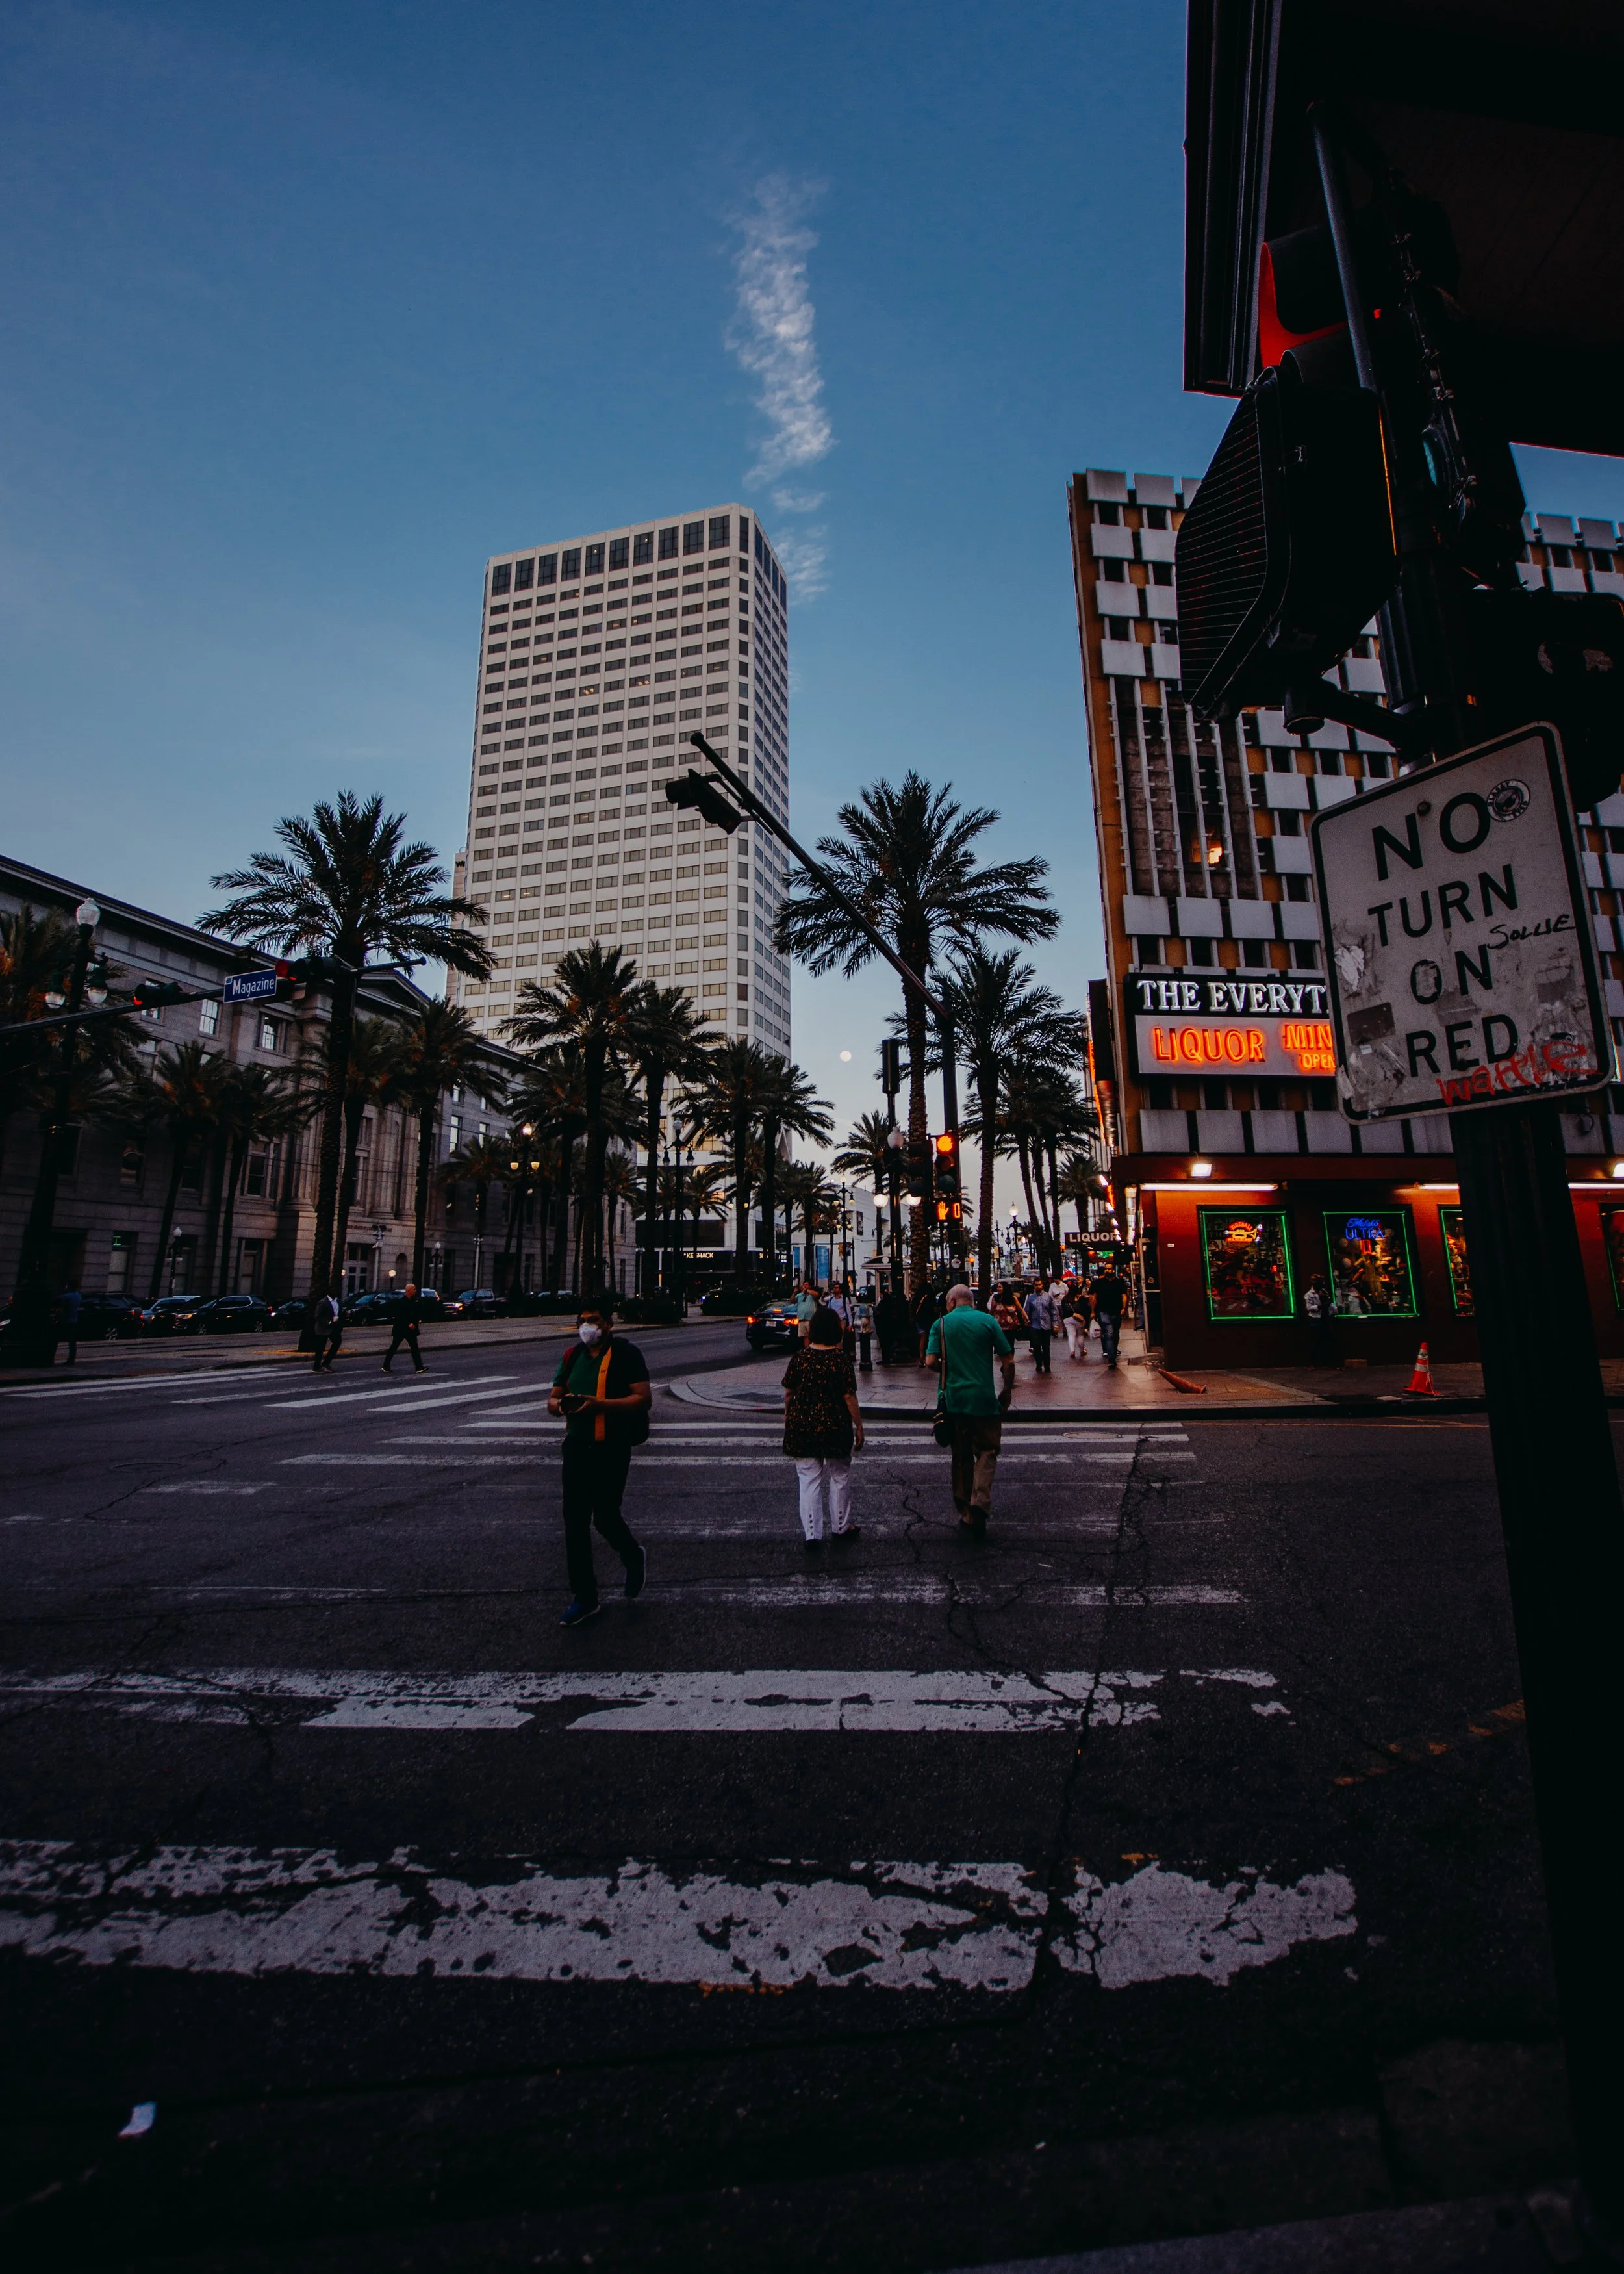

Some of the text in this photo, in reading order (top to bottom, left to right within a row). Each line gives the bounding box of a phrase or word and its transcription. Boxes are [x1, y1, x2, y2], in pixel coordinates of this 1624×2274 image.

[1371, 792, 1490, 881] NO
[1368, 863, 1518, 947] TURN
[233, 978, 274, 997] Magazine
[1137, 980, 1329, 1014] THE EVERYT
[1410, 944, 1493, 1004] ON
[1154, 1027, 1265, 1063] LIQUOR
[1406, 1014, 1518, 1077] RED
[1345, 1227, 1385, 1240] ULTRA
